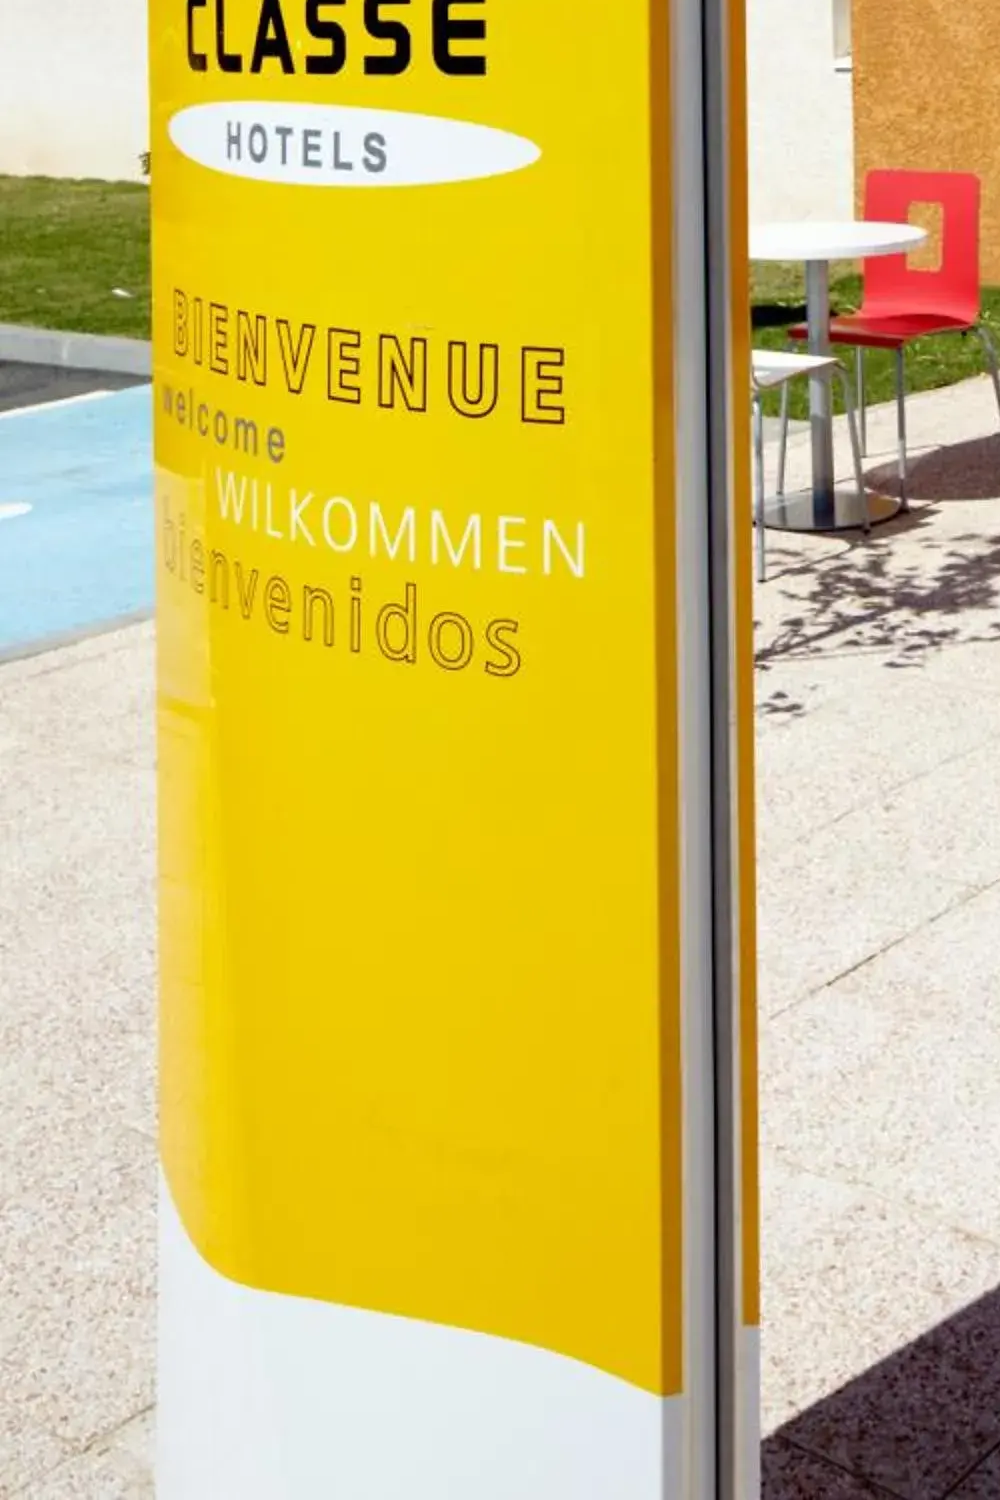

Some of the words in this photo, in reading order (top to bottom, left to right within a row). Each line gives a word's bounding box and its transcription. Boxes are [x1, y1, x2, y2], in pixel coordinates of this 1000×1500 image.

[226, 120, 387, 173] HOTELS
[173, 288, 565, 425] BIENVENUE
[160, 382, 286, 464] welcome
[215, 466, 585, 578] WILKOMMEN
